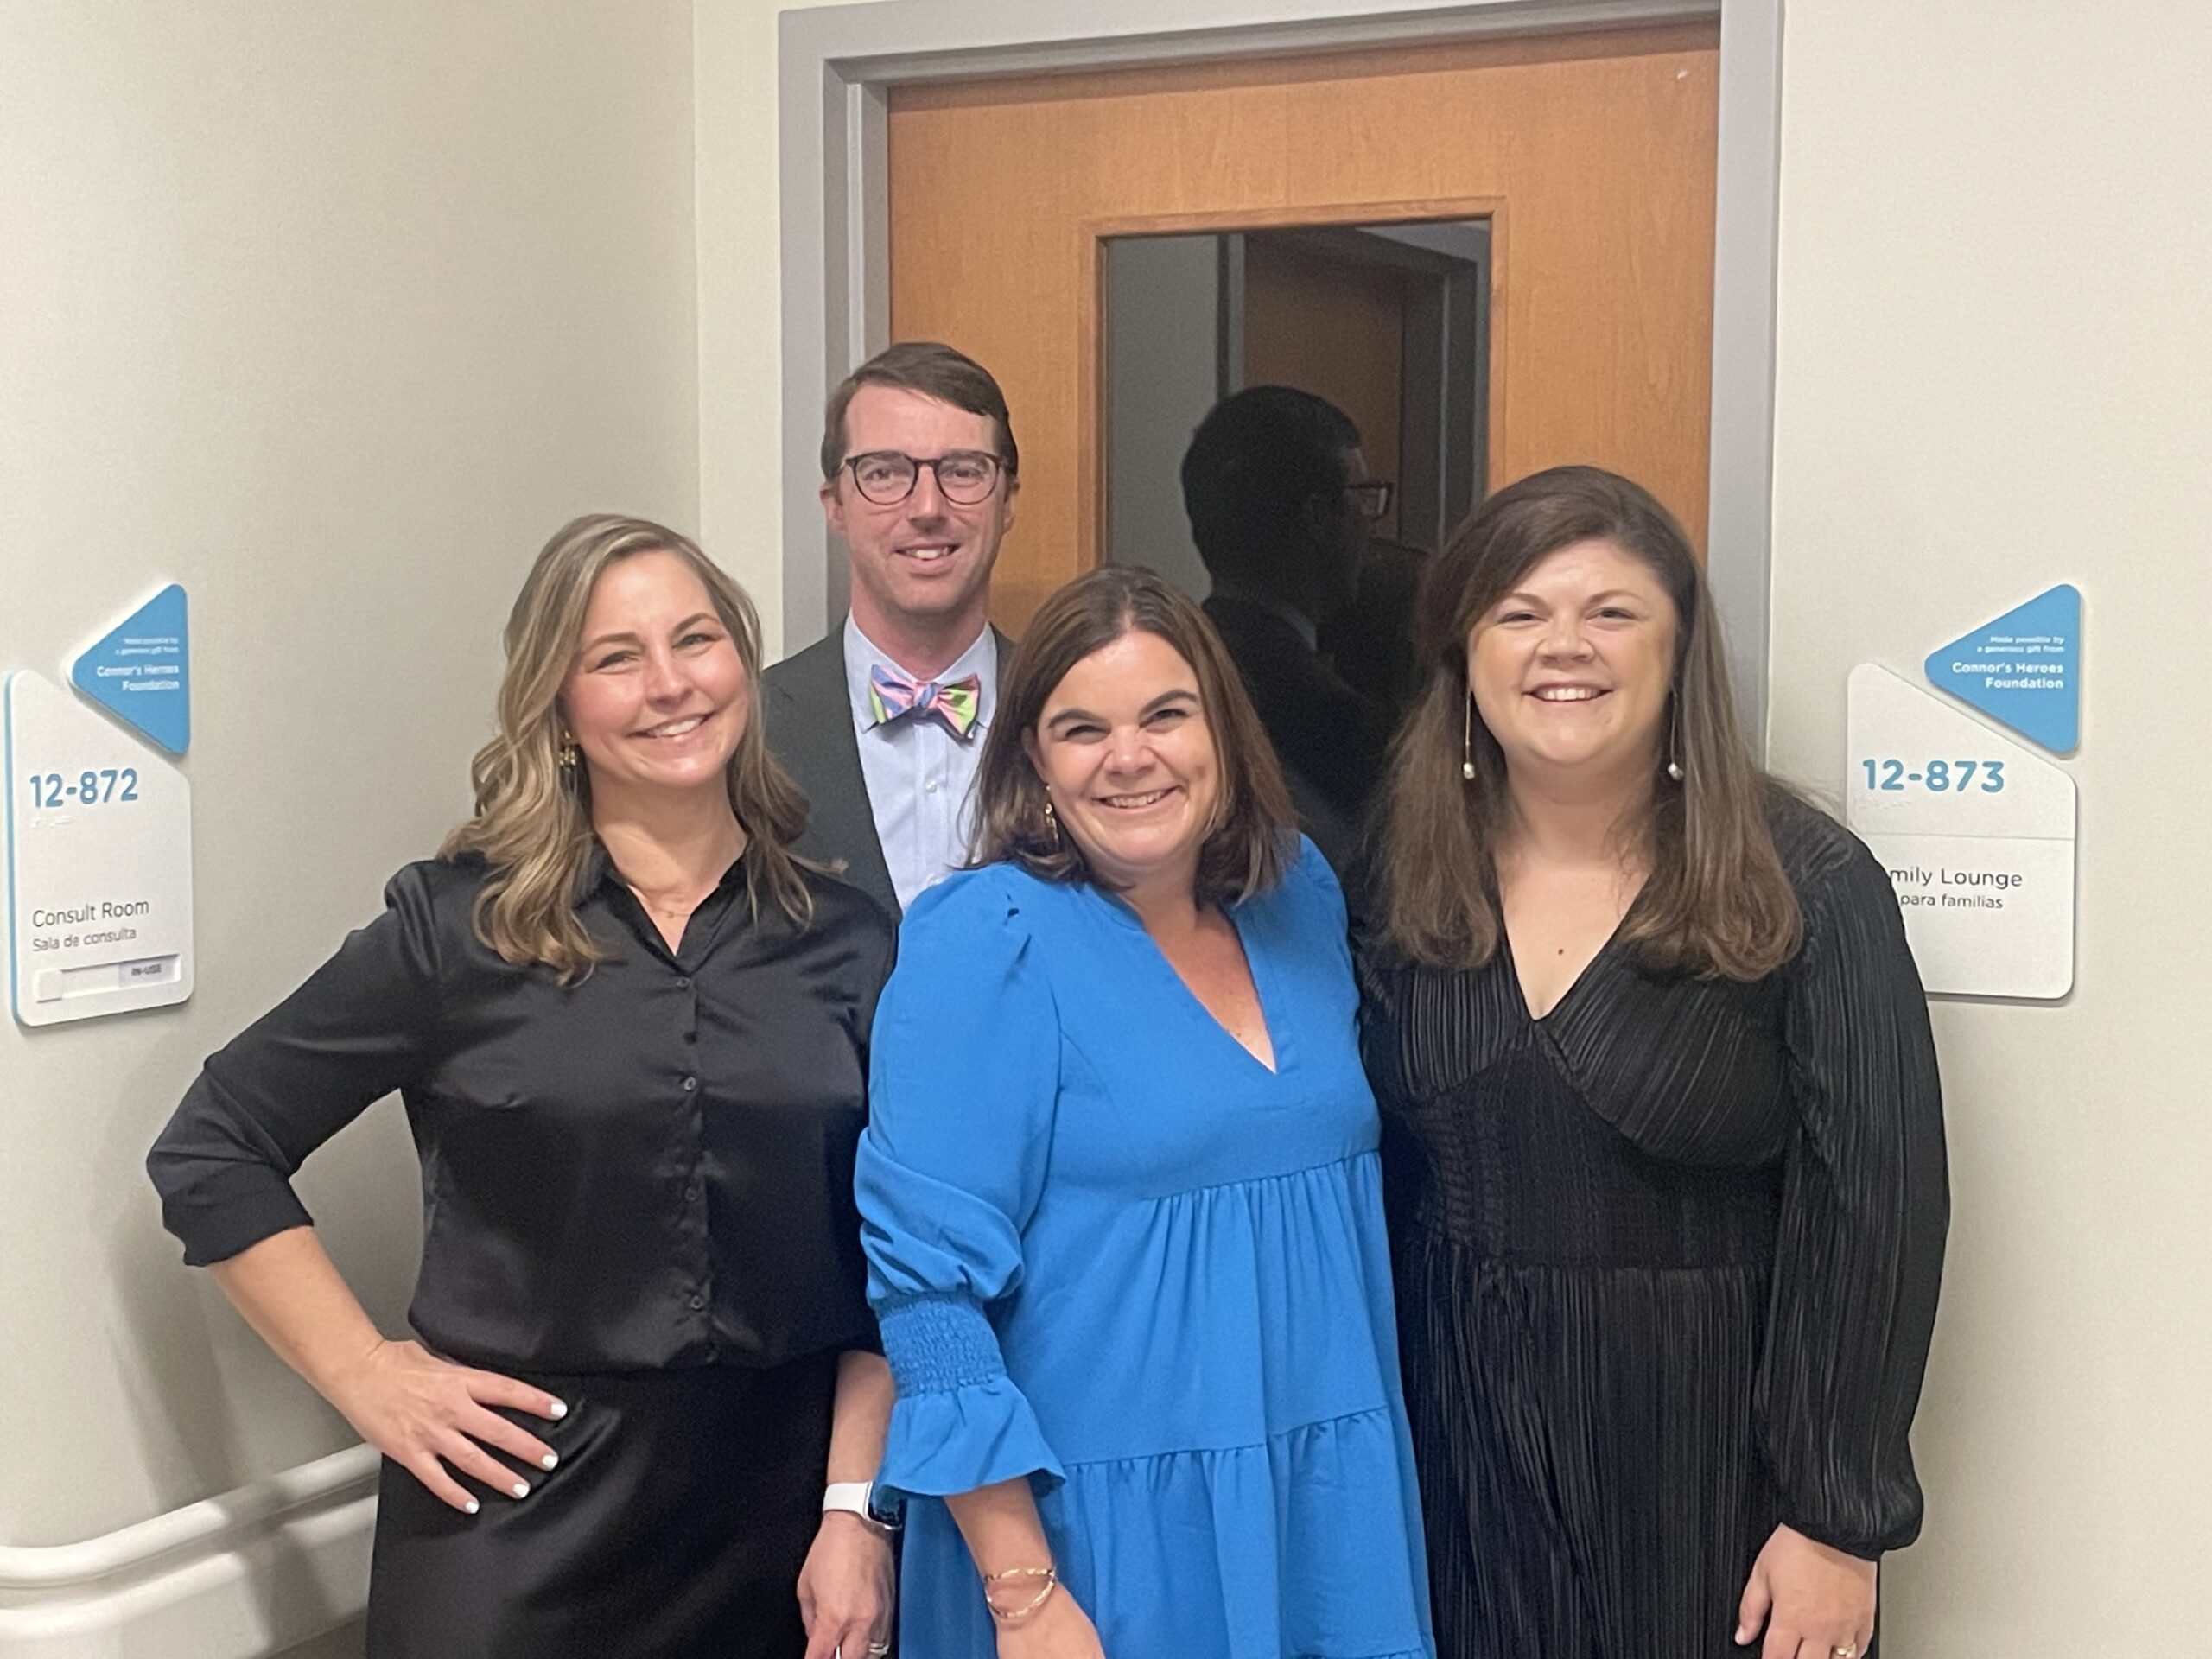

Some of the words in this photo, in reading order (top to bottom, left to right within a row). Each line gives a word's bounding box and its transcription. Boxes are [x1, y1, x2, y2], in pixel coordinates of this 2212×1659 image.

[1952, 661, 2012, 673] Connor's
[2016, 662, 2063, 673] Heroes
[1986, 677, 2063, 689] Foundation
[29, 767, 138, 808] 12-872
[1862, 758, 2005, 793] 12-873
[1890, 866, 1933, 887] mily
[1941, 868, 2023, 889] Lounge
[1901, 894, 1936, 907] para
[1942, 893, 2004, 908] familias
[32, 904, 96, 928] Consult
[102, 900, 149, 919] Room
[33, 937, 60, 952] Sala
[64, 934, 79, 948] de
[84, 927, 137, 945] consulta
